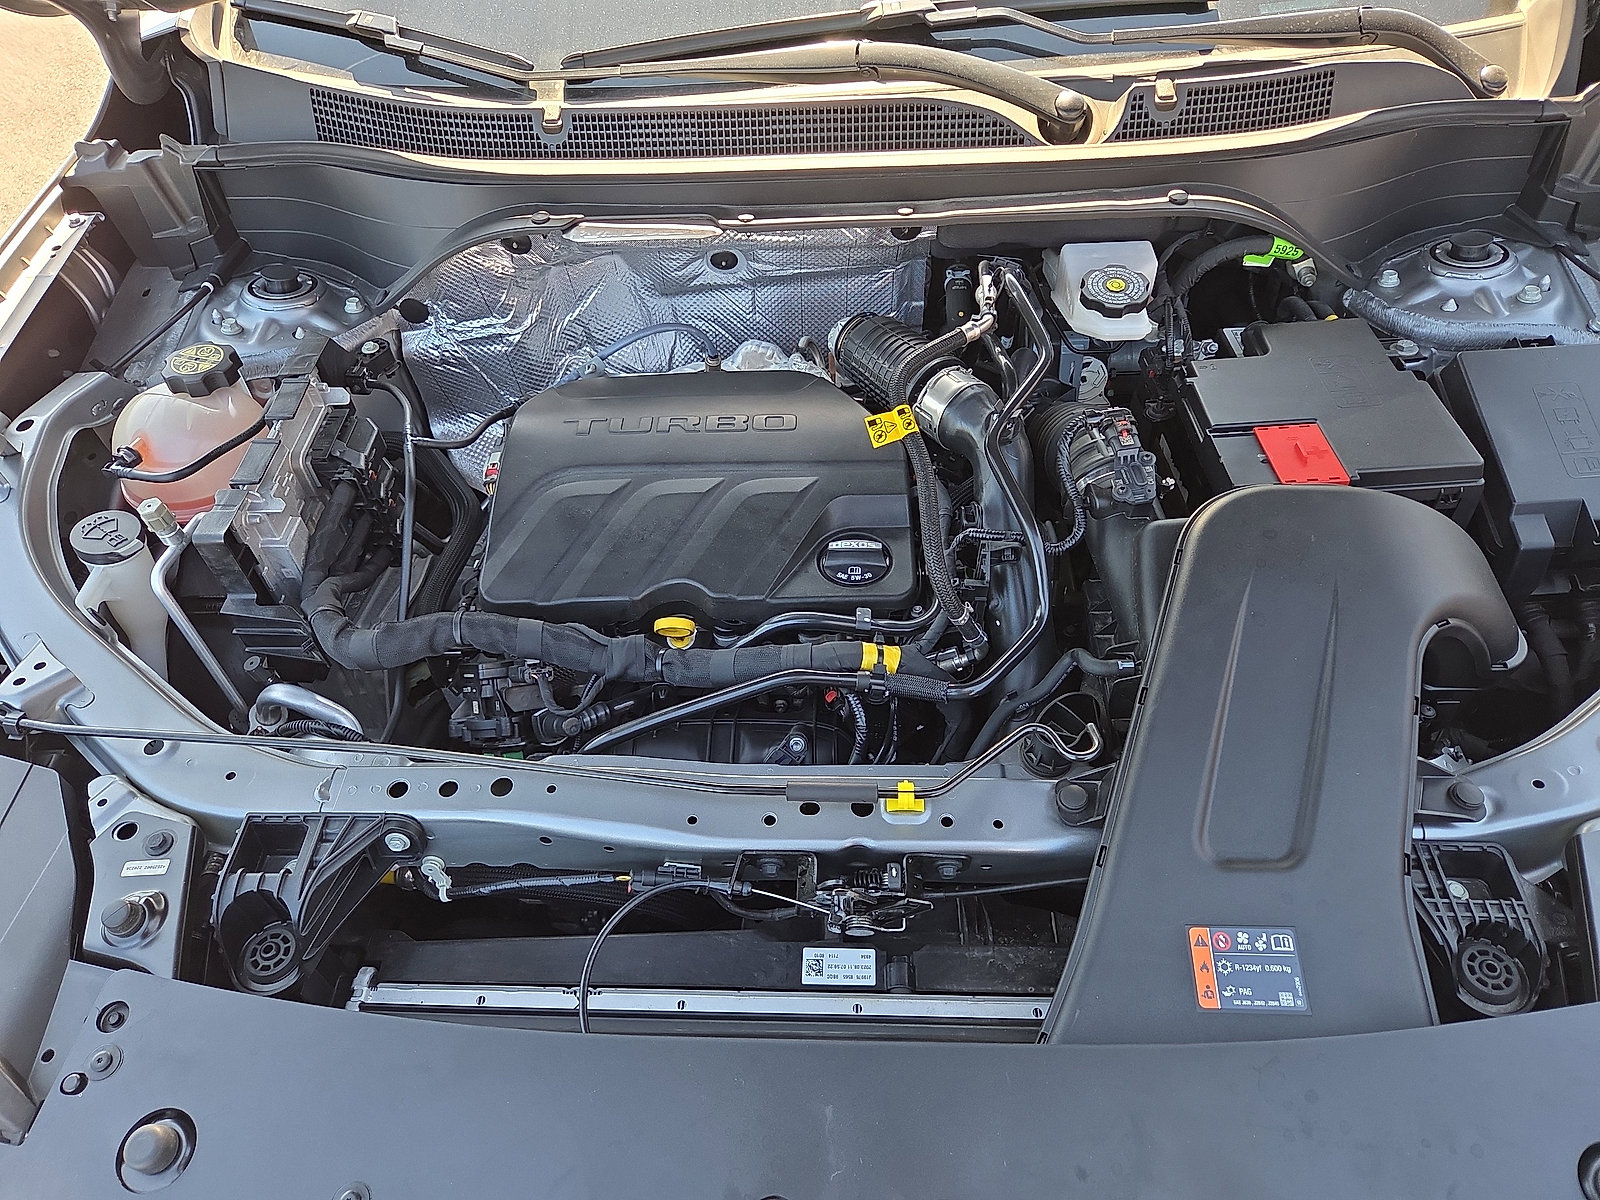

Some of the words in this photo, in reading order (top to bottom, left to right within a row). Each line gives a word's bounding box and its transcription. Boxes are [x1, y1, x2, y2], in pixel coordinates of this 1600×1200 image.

[1274, 244, 1299, 256] 5925
[563, 413, 798, 436] TURBO
[836, 572, 849, 580] SAE
[851, 572, 873, 581] 5W-30
[1234, 963, 1262, 973] R-1234yf
[1264, 964, 1282, 973] 0.600
[1282, 964, 1292, 974] kg
[1238, 987, 1253, 996] PAG
